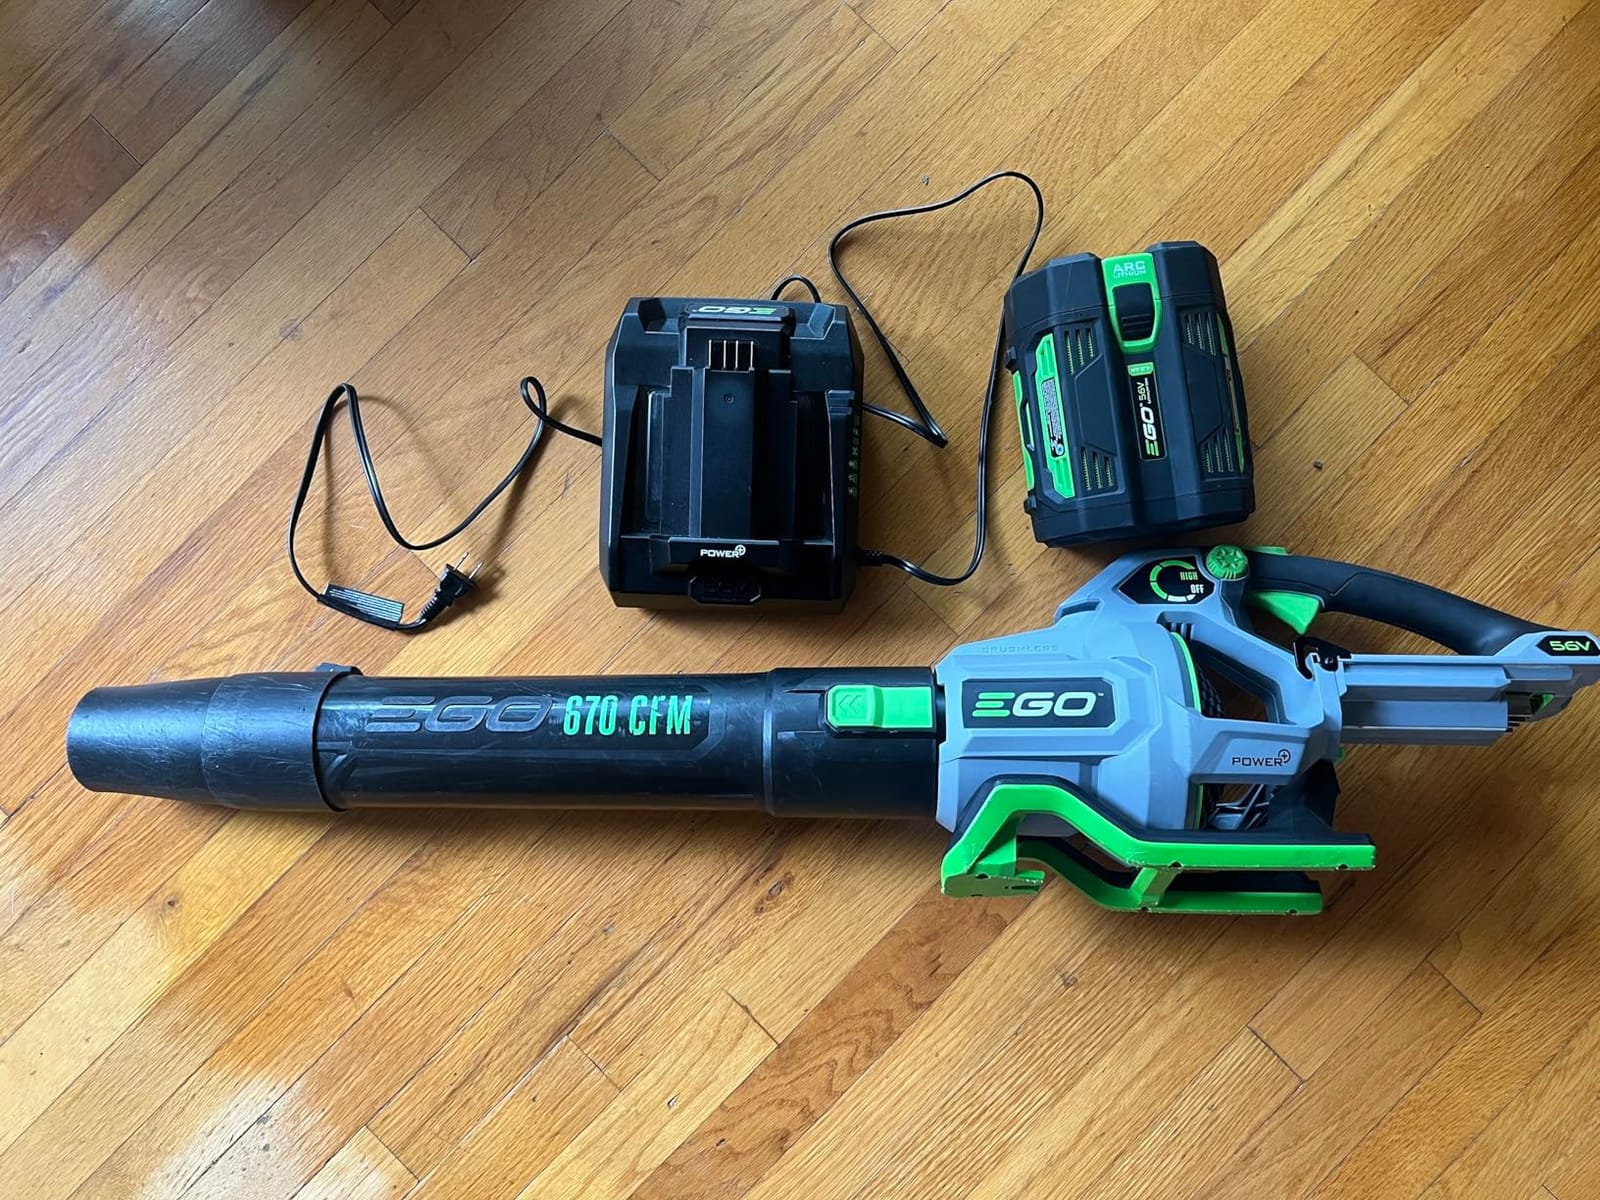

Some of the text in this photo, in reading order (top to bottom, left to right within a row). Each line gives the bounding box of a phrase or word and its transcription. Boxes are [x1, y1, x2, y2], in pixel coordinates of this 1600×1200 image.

[1113, 260, 1146, 273] ARC
[1113, 270, 1147, 279] LITHIUM
[698, 305, 777, 315] EGO
[1137, 381, 1147, 401] 56V
[1141, 406, 1160, 457] EGO
[1180, 571, 1199, 581] HIGH
[1190, 584, 1205, 594] OFF
[1549, 640, 1590, 651] 56V
[972, 691, 1097, 717] EGO
[365, 695, 694, 736] EGO 670 CFM
